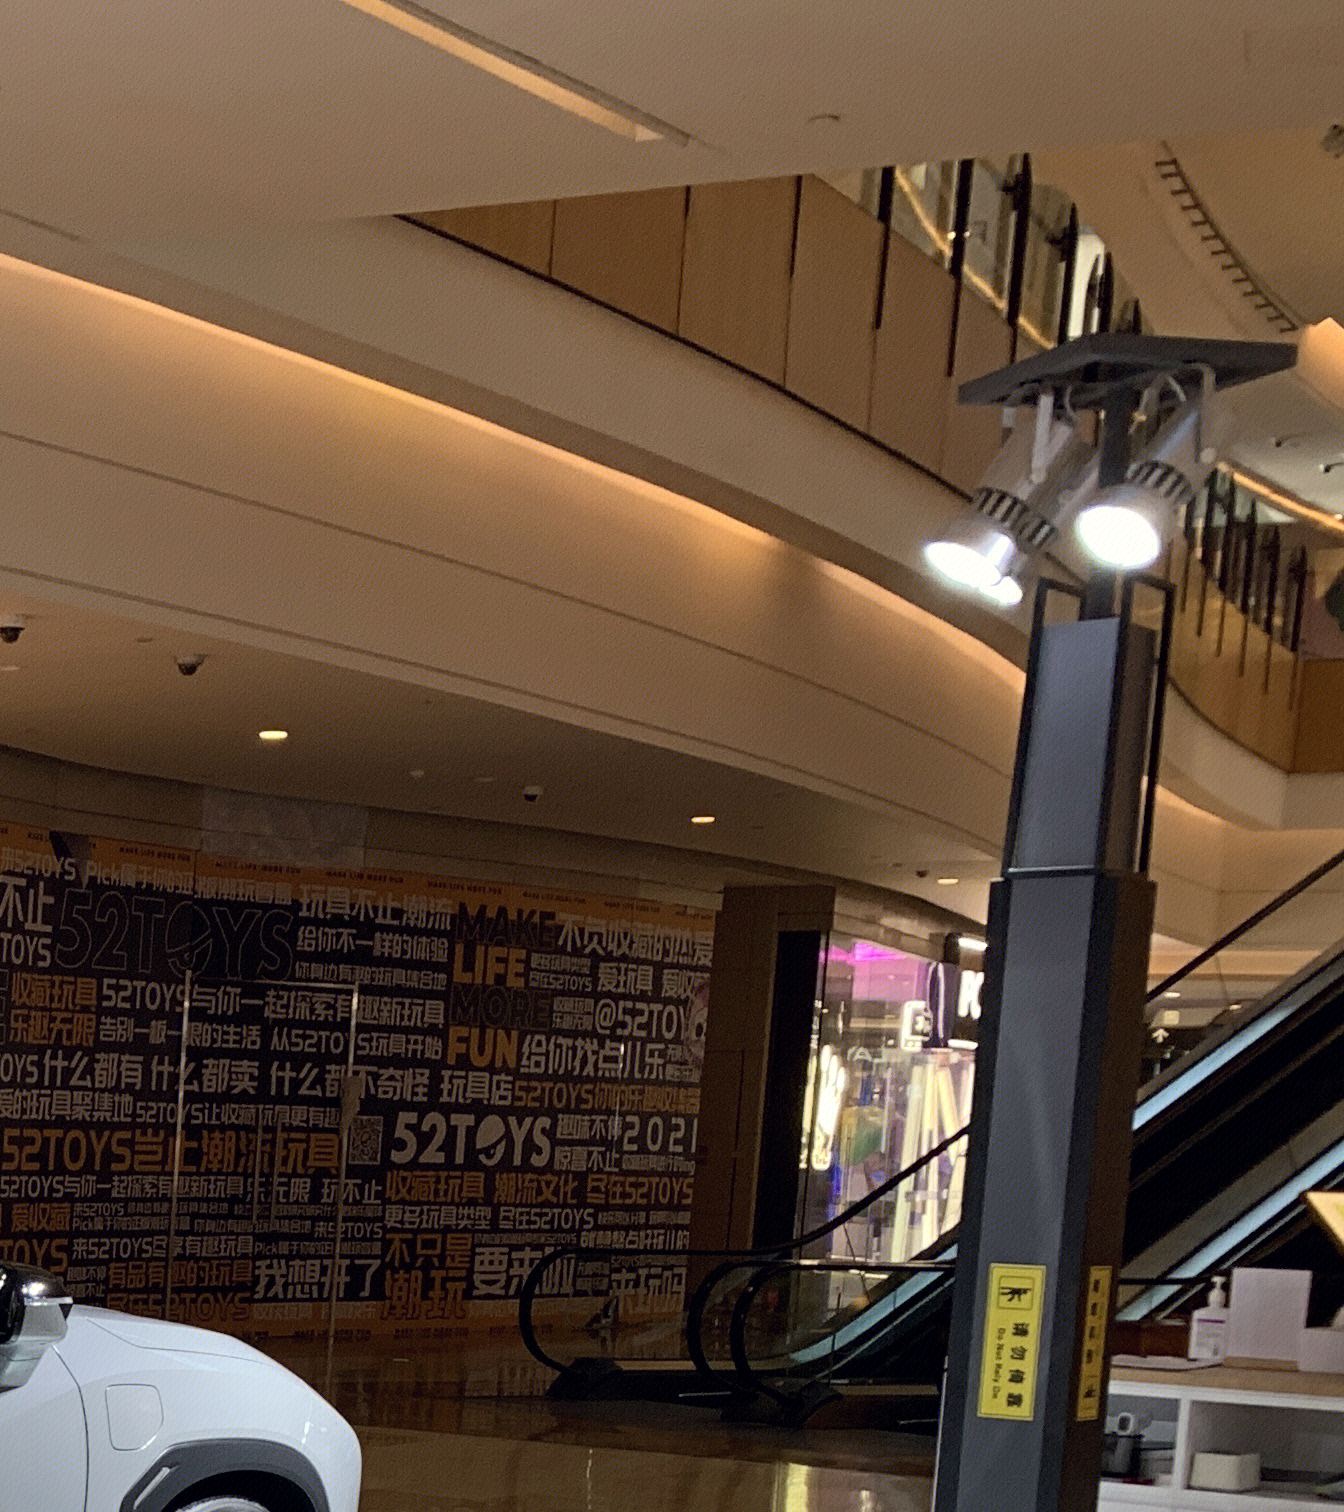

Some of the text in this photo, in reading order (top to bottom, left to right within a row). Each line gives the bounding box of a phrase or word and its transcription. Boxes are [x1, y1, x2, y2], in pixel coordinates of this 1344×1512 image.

[295, 925, 449, 963] 给你不一样的体验
[451, 941, 528, 989] LIFE
[597, 961, 654, 997] 爱玩具
[10, 971, 99, 1013] 收藏玩具
[446, 1025, 519, 1069] FUN
[439, 1068, 515, 1107] 玩具店
[389, 1110, 552, 1168] 52TOYS
[622, 1115, 700, 1155] 2021
[385, 1169, 696, 1205] 收藏玩具 潮流文化 尽在52TOYS
[10, 1202, 72, 1234] 爱收藏
[383, 1204, 493, 1231] 更多玩具类型
[499, 1206, 596, 1231] 尽在52TOYS
[384, 1231, 474, 1269] 不只是
[253, 1257, 383, 1301] 我想开了
[381, 1268, 468, 1320] 潮玩
